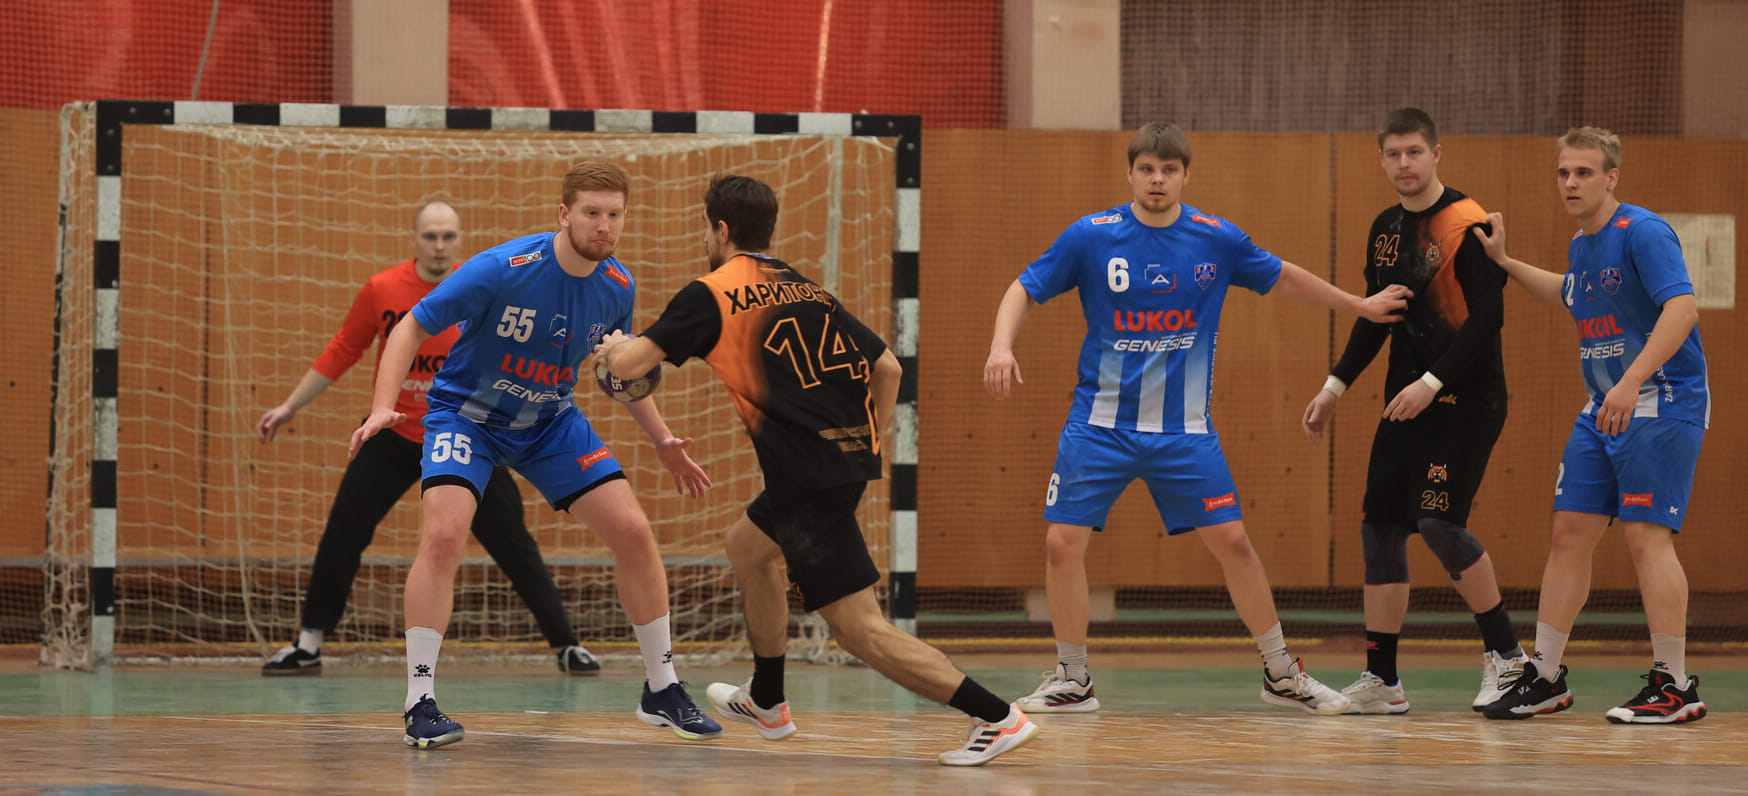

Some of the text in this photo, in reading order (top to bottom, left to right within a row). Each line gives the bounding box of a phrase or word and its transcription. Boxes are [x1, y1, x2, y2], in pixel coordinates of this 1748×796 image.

[1375, 233, 1400, 267] 24
[1107, 257, 1130, 293] 6
[723, 281, 837, 316] ХАРИТОН
[496, 305, 537, 344] 55
[1578, 314, 1624, 339] KOIL
[763, 313, 868, 389] 14
[1113, 335, 1196, 353] GENESIS
[430, 432, 472, 465] 55
[1045, 472, 1061, 507] 6
[1421, 489, 1450, 512] 24
